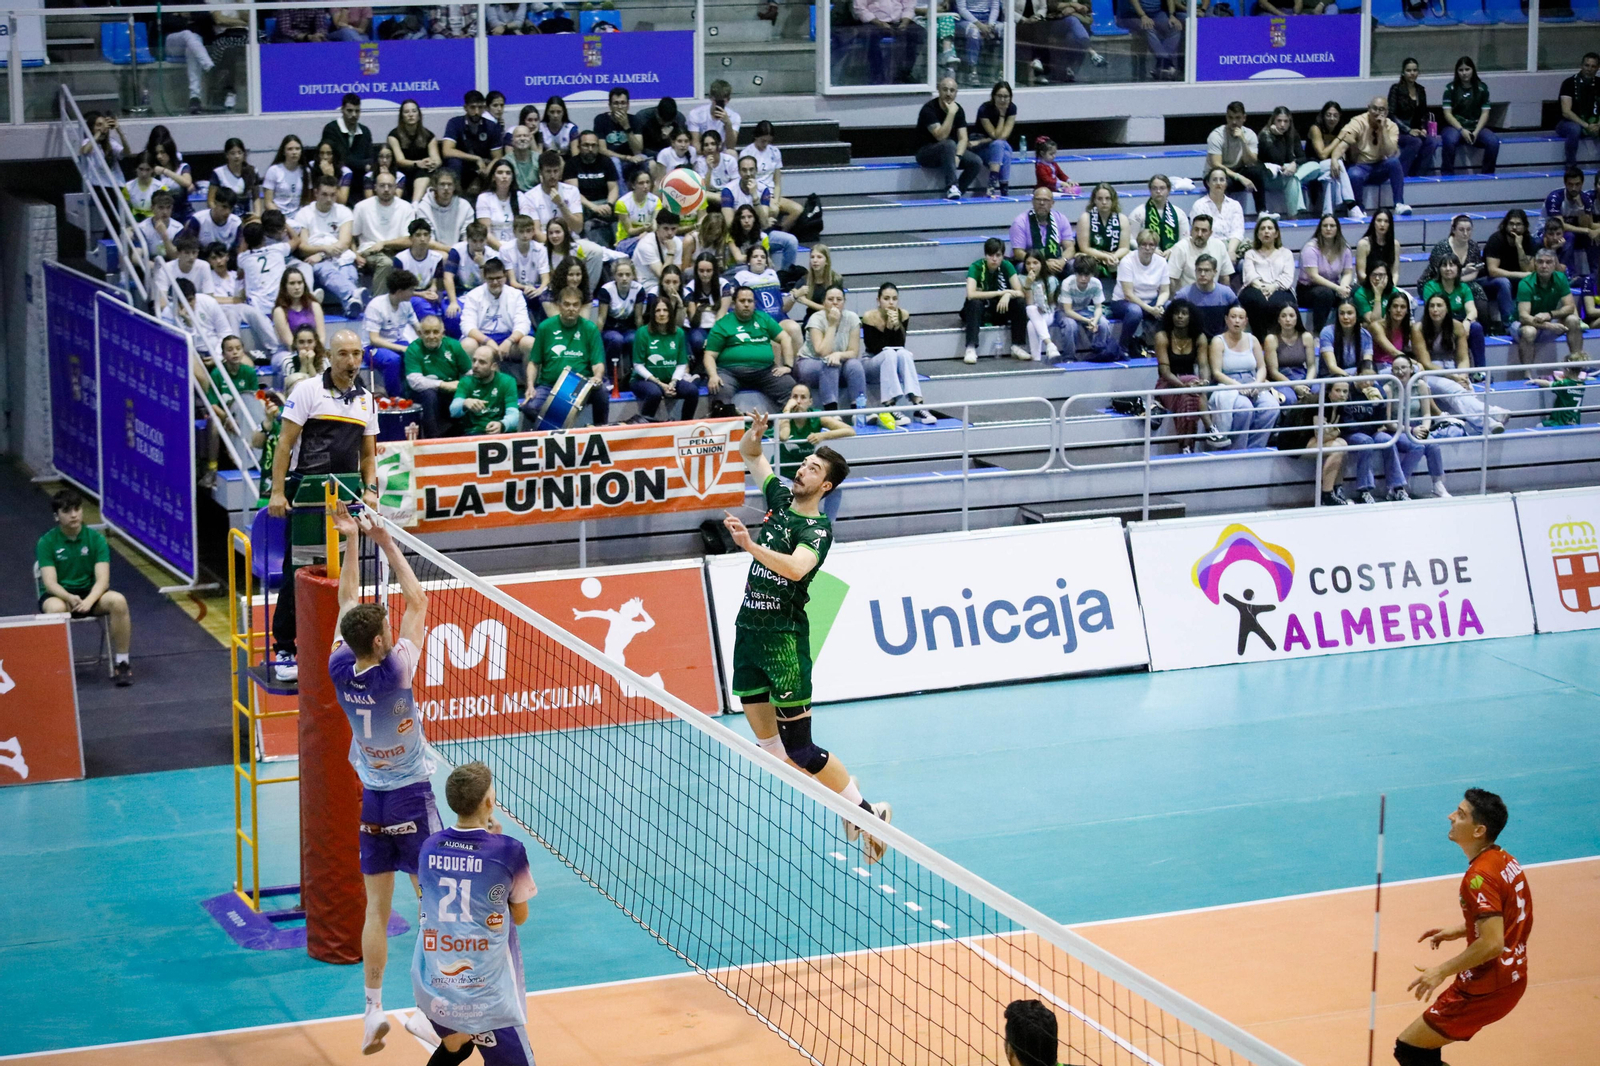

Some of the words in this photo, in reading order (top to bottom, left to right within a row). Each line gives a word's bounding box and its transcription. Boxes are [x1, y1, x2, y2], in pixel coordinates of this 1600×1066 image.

[1219, 52, 1278, 65] DIPUTACIÓN
[1280, 53, 1292, 64] DE
[1294, 51, 1335, 63] ALMERÍA
[299, 81, 370, 95] DIPUTACIÓN
[373, 83, 388, 92] DE
[390, 79, 440, 92] ALMERÍA
[525, 73, 593, 86] DIPUTACIÓN
[595, 74, 609, 84] DE
[612, 71, 659, 84] ALMERÍA
[670, 190, 687, 204] CVA
[257, 255, 270, 274] 2
[478, 429, 612, 476] PEÑA
[696, 445, 723, 454] UNION
[425, 484, 486, 520] LA
[504, 469, 665, 514] UNION
[1309, 560, 1422, 595] COSTA
[1429, 556, 1472, 584] DE
[869, 578, 1115, 656] Unicaja
[1283, 589, 1484, 652] ALMERÍA
[415, 693, 499, 722] VOLEIBOL
[502, 685, 602, 716] MASCULINA
[356, 708, 372, 739] 7
[365, 744, 405, 759] Soria
[428, 854, 483, 873] PEQUEÑO
[438, 876, 474, 923] 21
[440, 934, 489, 952] Soria
